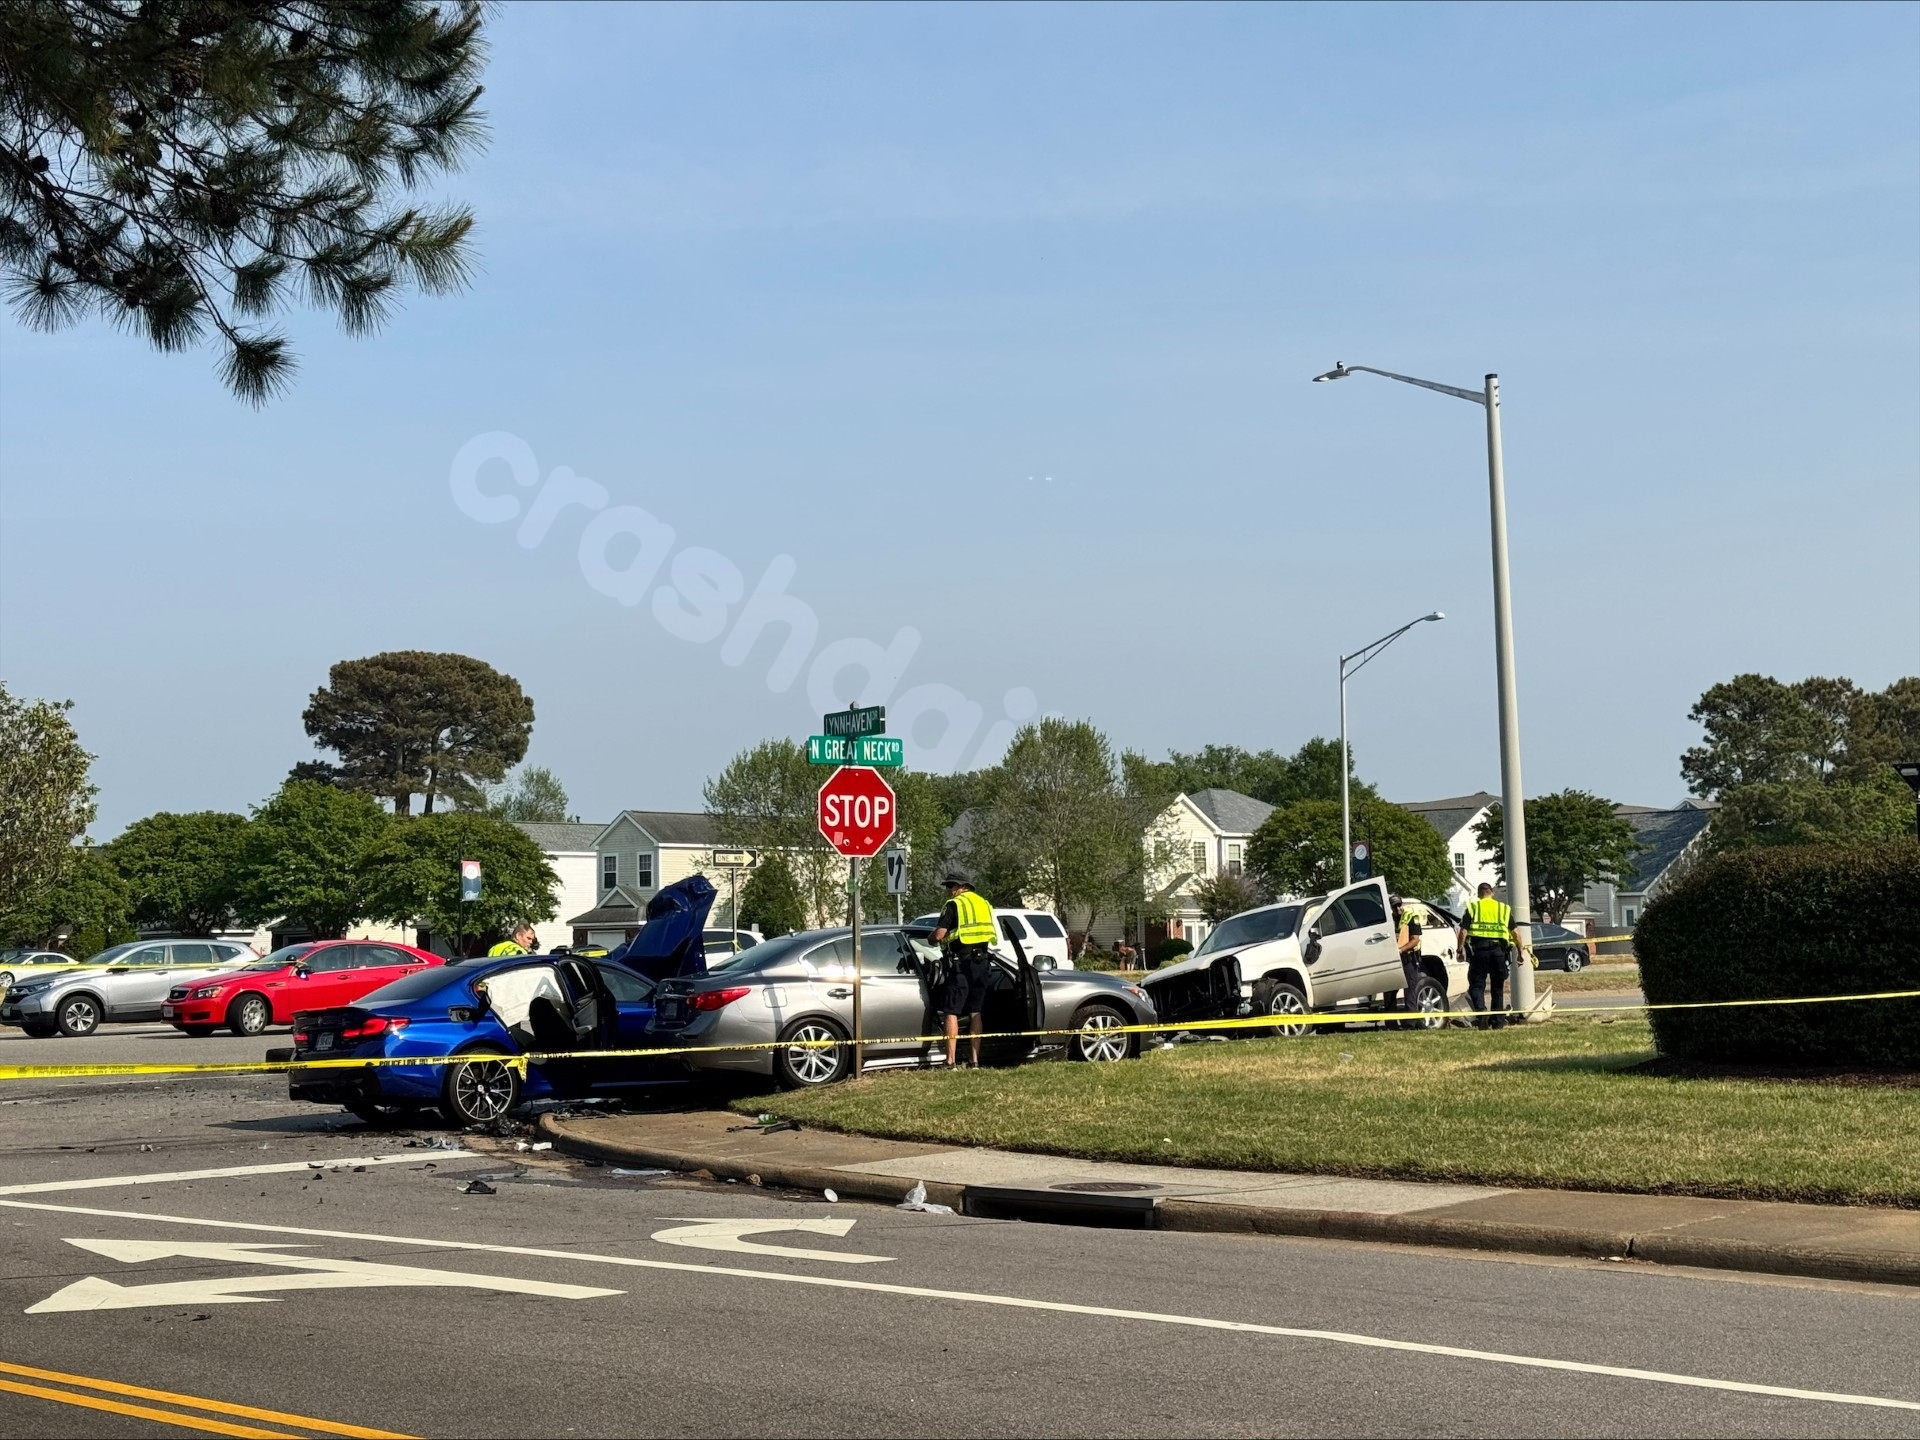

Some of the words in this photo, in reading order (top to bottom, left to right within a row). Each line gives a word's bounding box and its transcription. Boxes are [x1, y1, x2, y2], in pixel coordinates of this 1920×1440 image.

[825, 712, 872, 736] LYNNHAVEN
[811, 739, 819, 759] N
[825, 739, 858, 760] GREAT
[863, 741, 892, 761] NECK
[892, 742, 900, 753] RD
[824, 794, 889, 828] STOP
